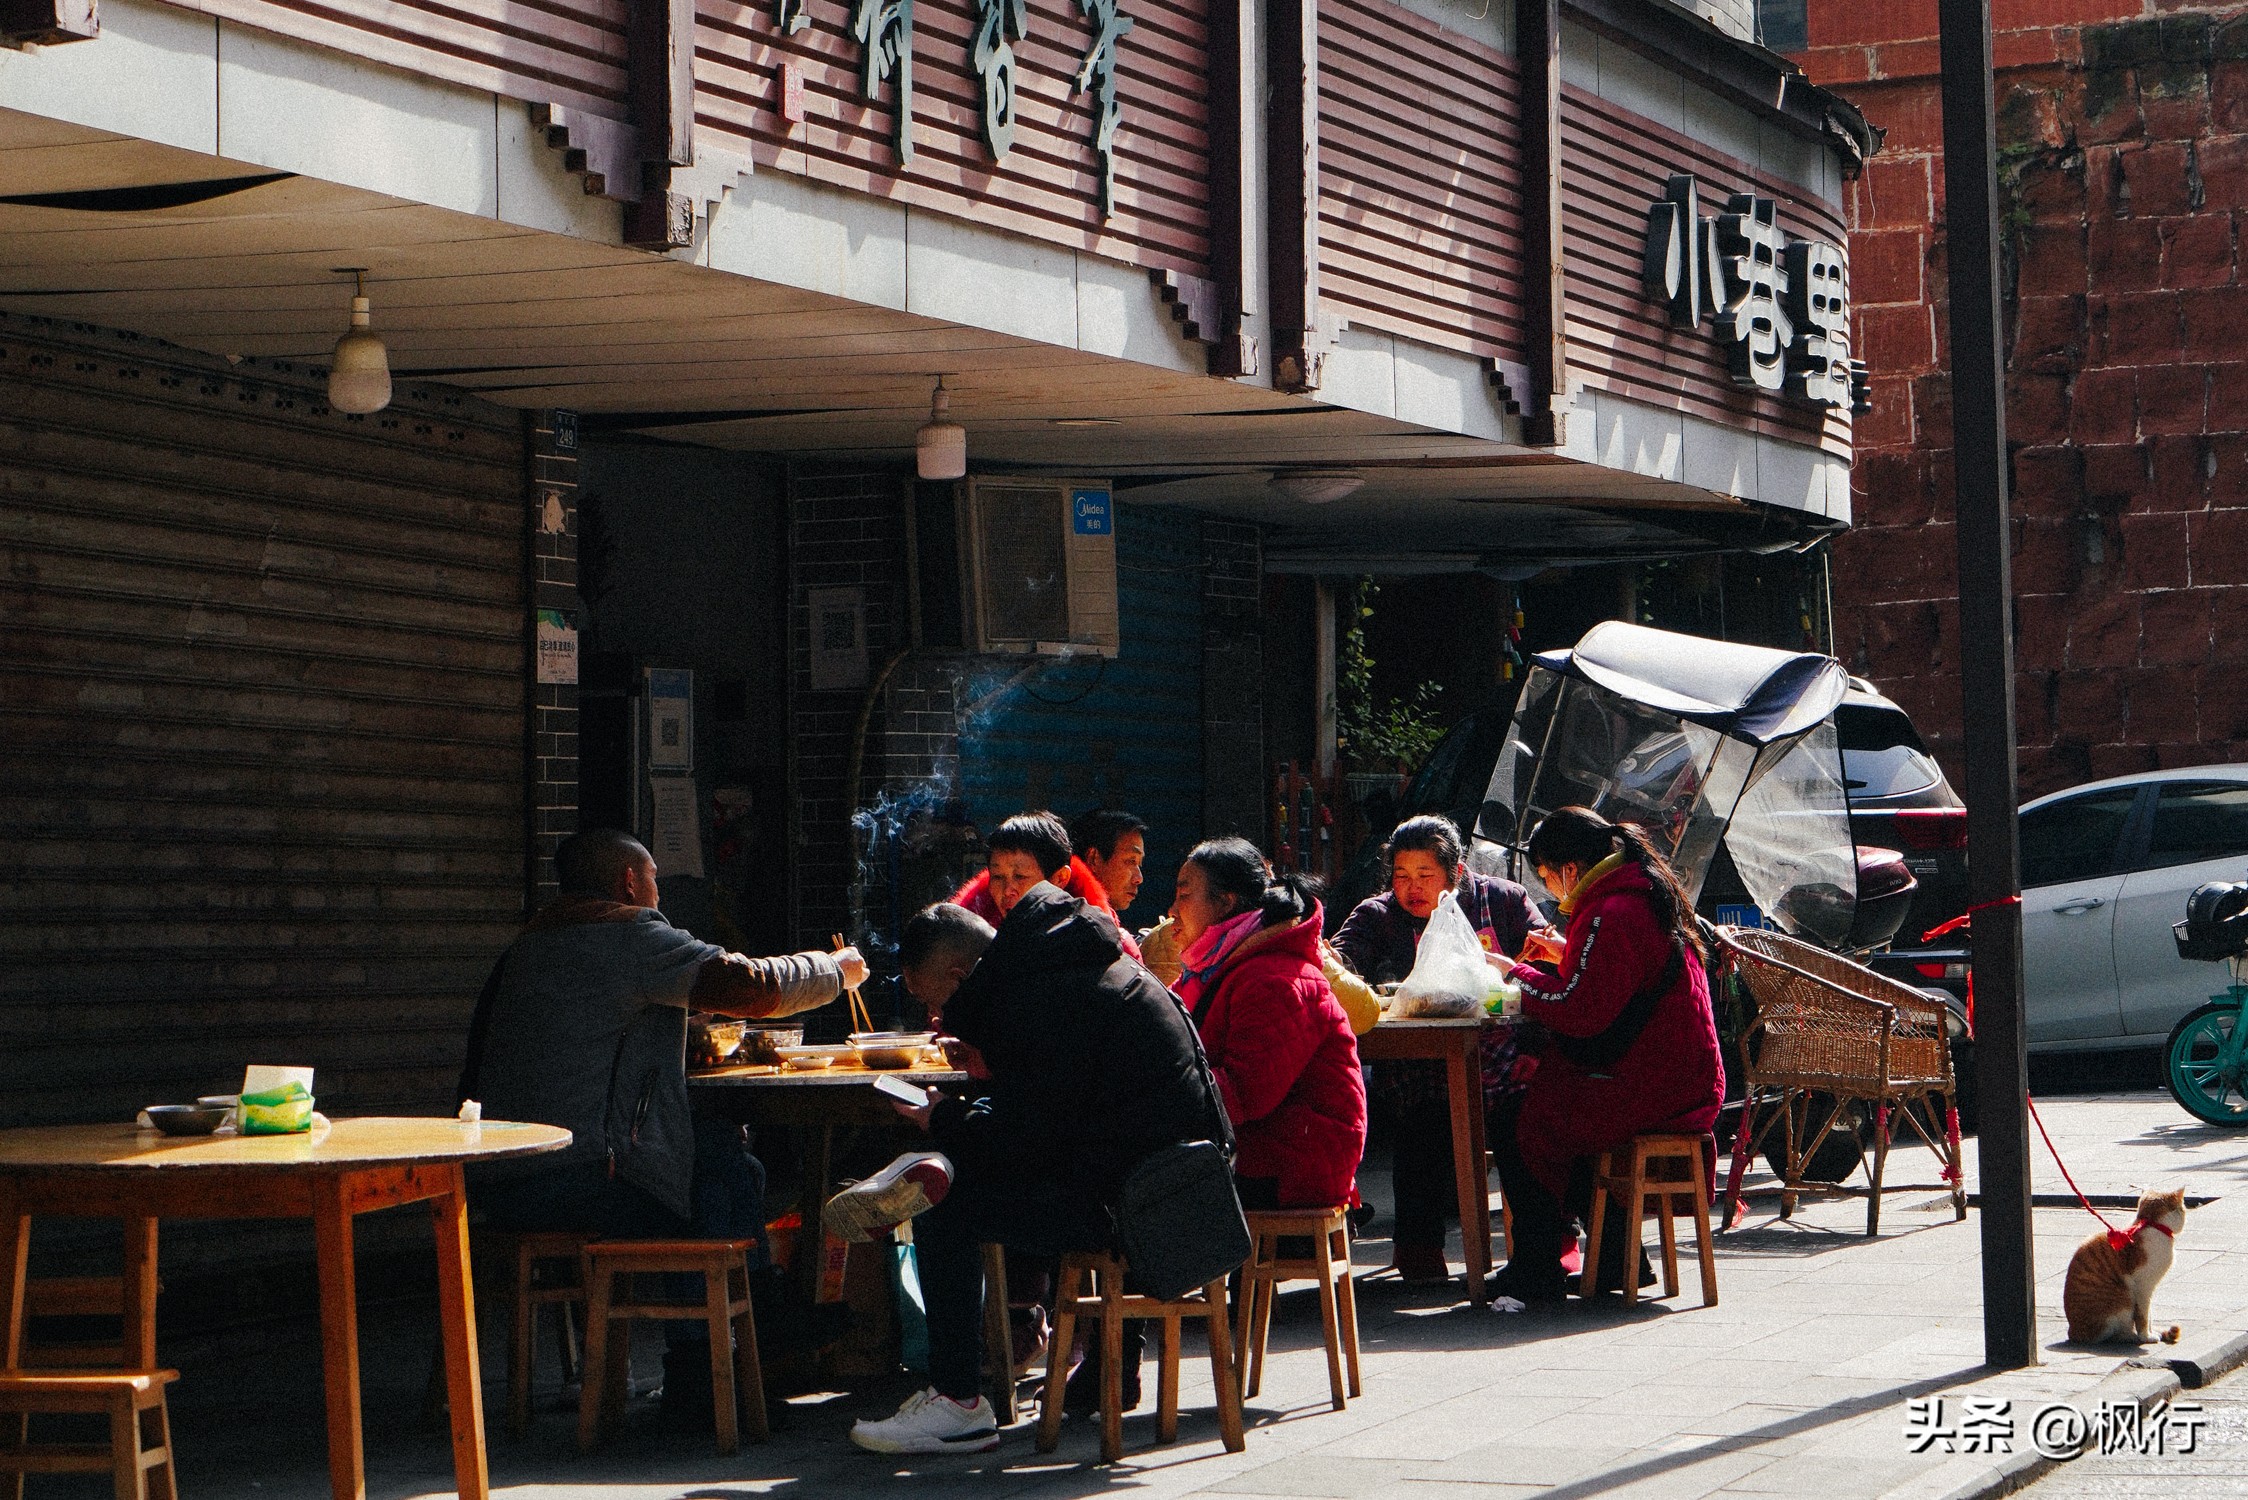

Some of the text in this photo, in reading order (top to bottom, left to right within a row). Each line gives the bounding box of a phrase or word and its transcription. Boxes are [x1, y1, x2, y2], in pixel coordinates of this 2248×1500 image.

[1662, 174, 1851, 411] 小巷里
[560, 429, 573, 446] 249
[1078, 502, 1105, 516] Midea
[1087, 519, 1101, 529] 美的
